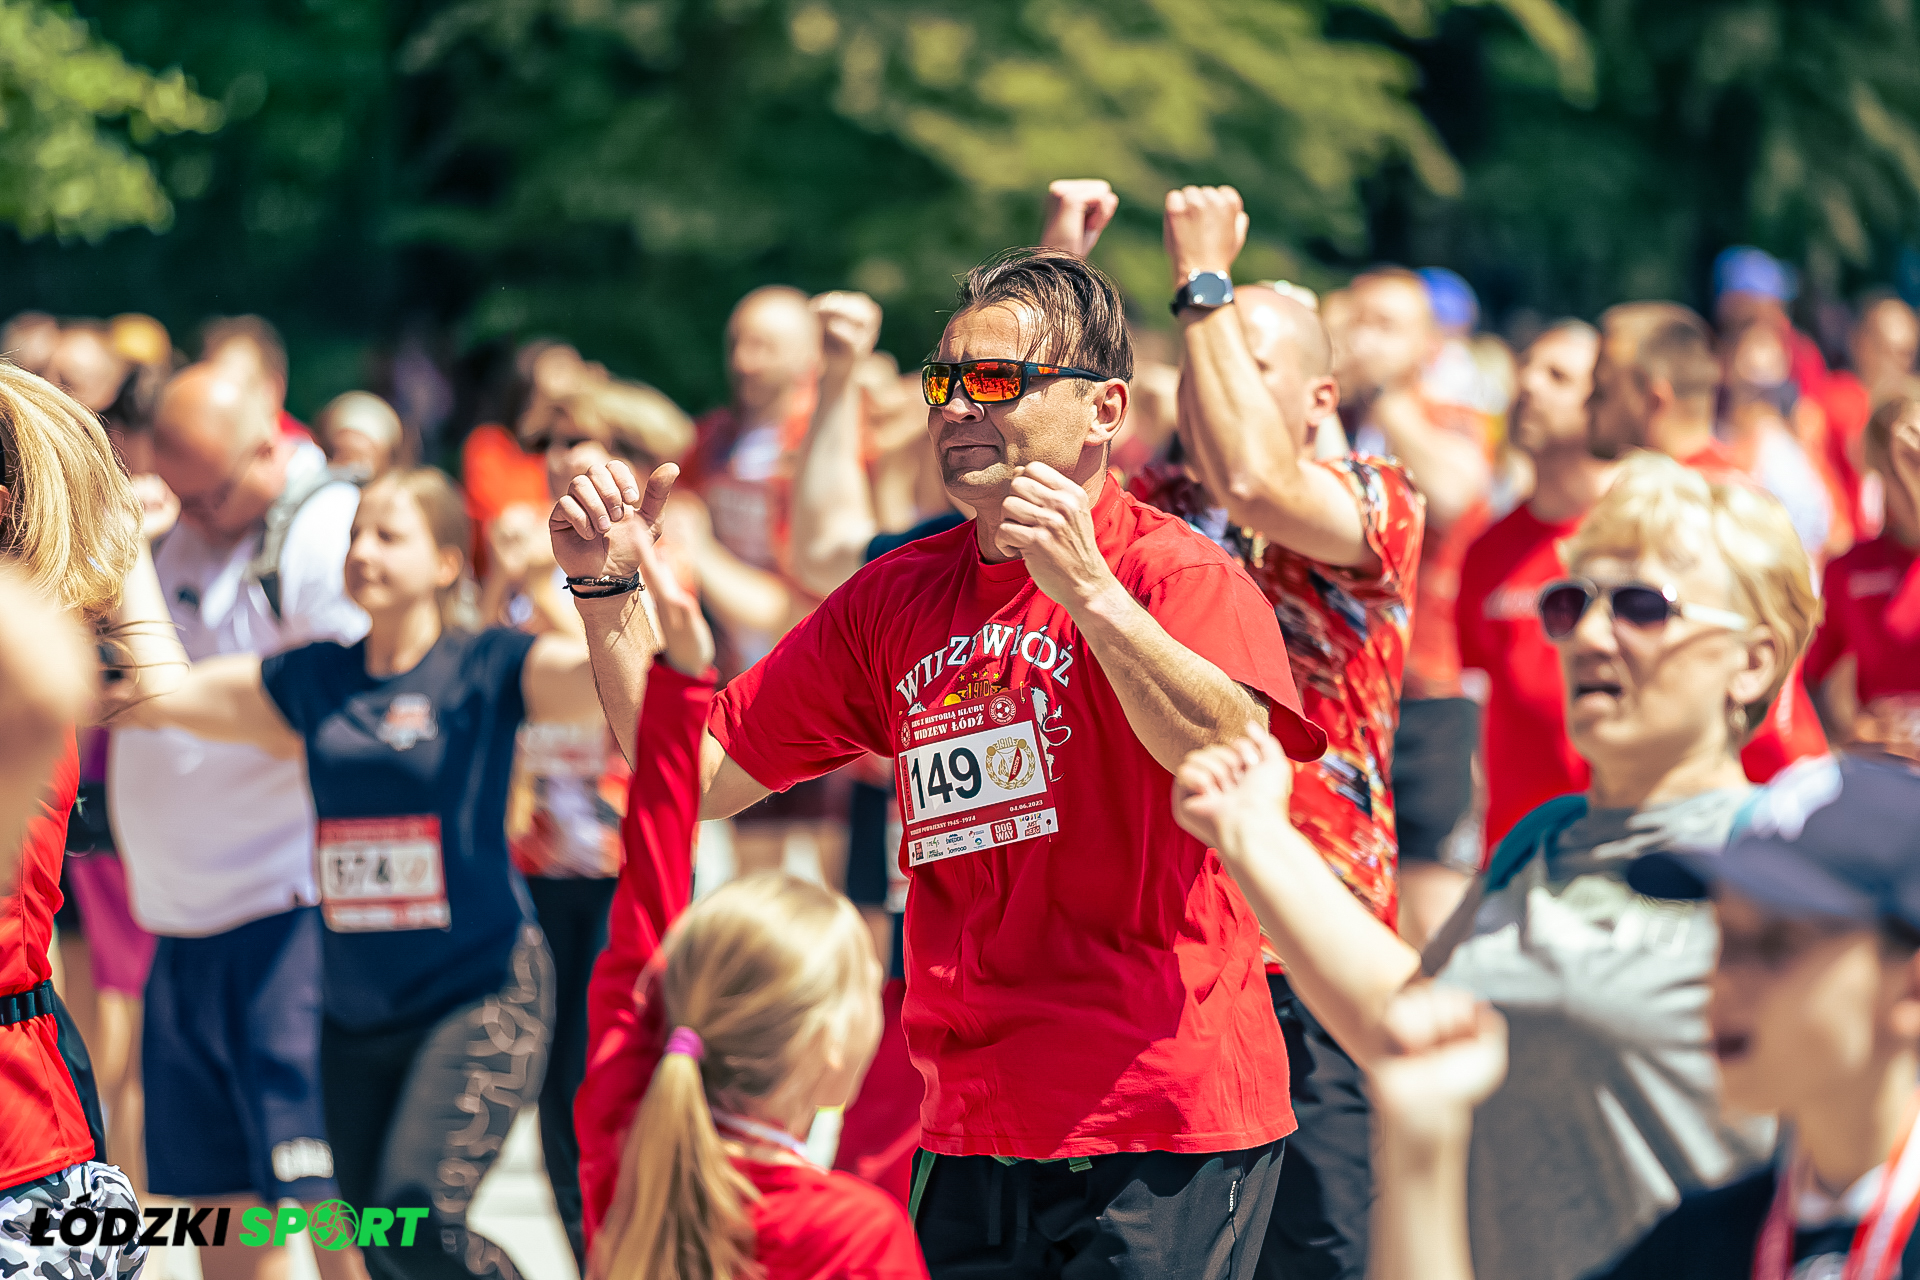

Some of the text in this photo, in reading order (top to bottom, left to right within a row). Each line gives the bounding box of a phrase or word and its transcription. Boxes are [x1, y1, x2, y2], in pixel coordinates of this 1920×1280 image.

[896, 623, 1013, 706] WIZW
[925, 711, 956, 724] HISTORIĄ
[957, 704, 985, 716] KLUBU
[913, 723, 948, 741] WIDZEW
[951, 713, 984, 731] ŁÓDŹ
[910, 747, 982, 809] 149
[1009, 799, 1044, 812] 04.06.2023
[947, 815, 976, 827] 1945-1974
[994, 822, 1013, 833] DOG
[995, 830, 1014, 842] WAY
